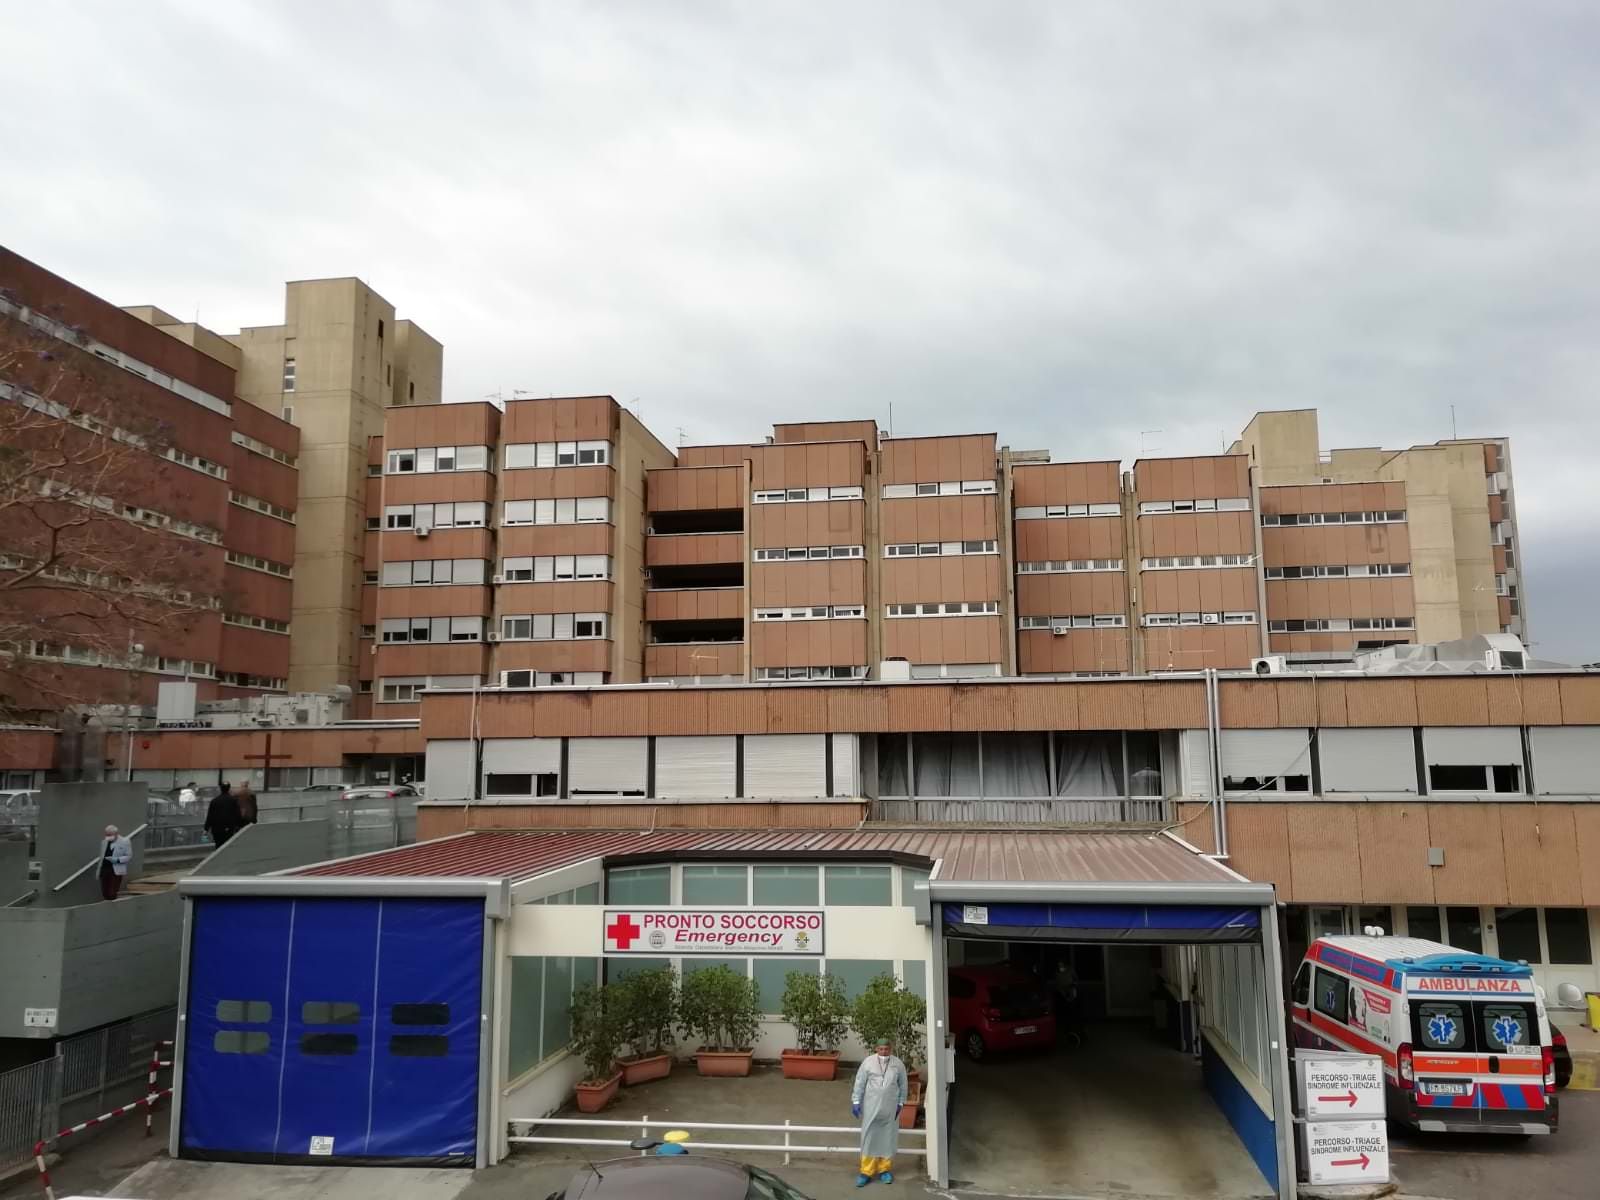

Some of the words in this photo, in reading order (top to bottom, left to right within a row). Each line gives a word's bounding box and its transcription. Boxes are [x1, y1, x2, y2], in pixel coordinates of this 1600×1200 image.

[643, 914, 715, 929] PRONTO
[720, 914, 820, 930] SOCCORSO
[674, 929, 783, 945] Emergency
[1418, 978, 1521, 992] AMBULANZA
[1311, 1146, 1341, 1155] SINDROME
[1342, 1145, 1386, 1153] INFLUENZALE
